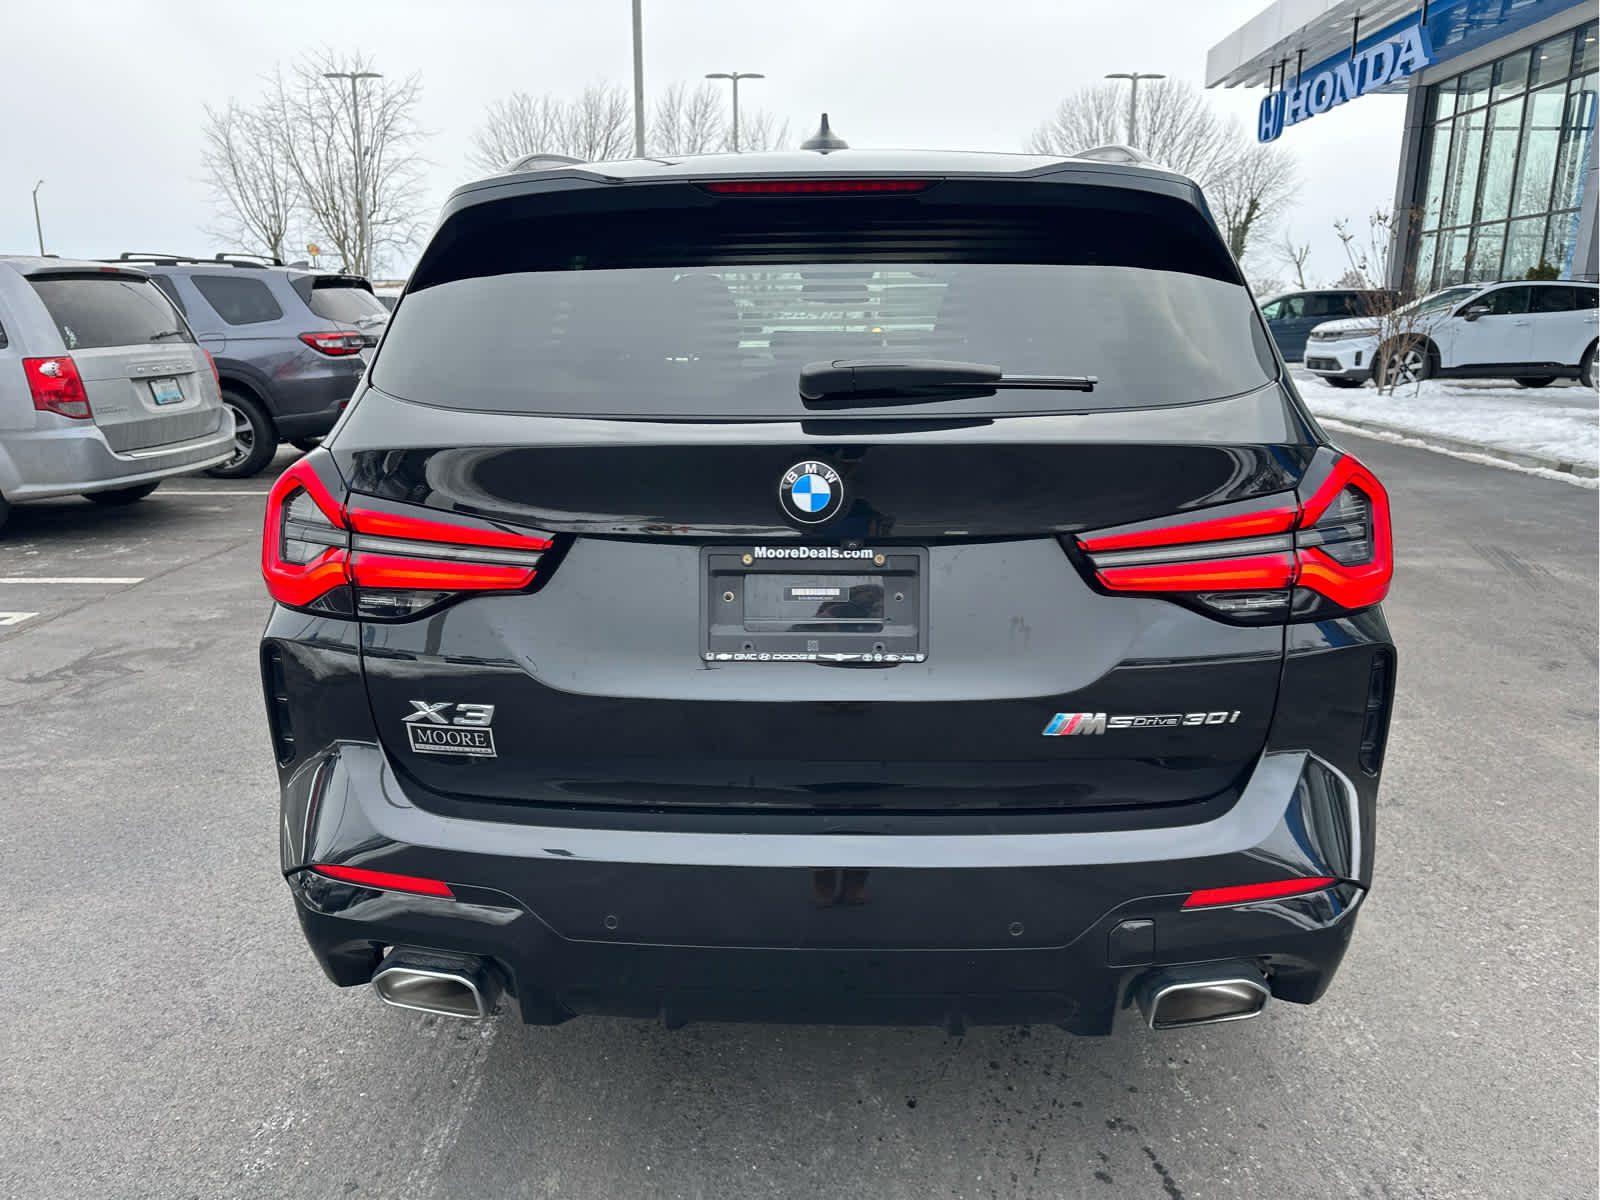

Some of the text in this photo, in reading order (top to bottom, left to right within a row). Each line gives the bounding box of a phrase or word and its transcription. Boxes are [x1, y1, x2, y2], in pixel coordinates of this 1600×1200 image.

[1284, 24, 1431, 126] HONDA
[785, 463, 838, 485] BMW
[754, 546, 874, 559] MooreDeals.com
[400, 700, 495, 726] X3
[416, 728, 487, 747] MOORE
